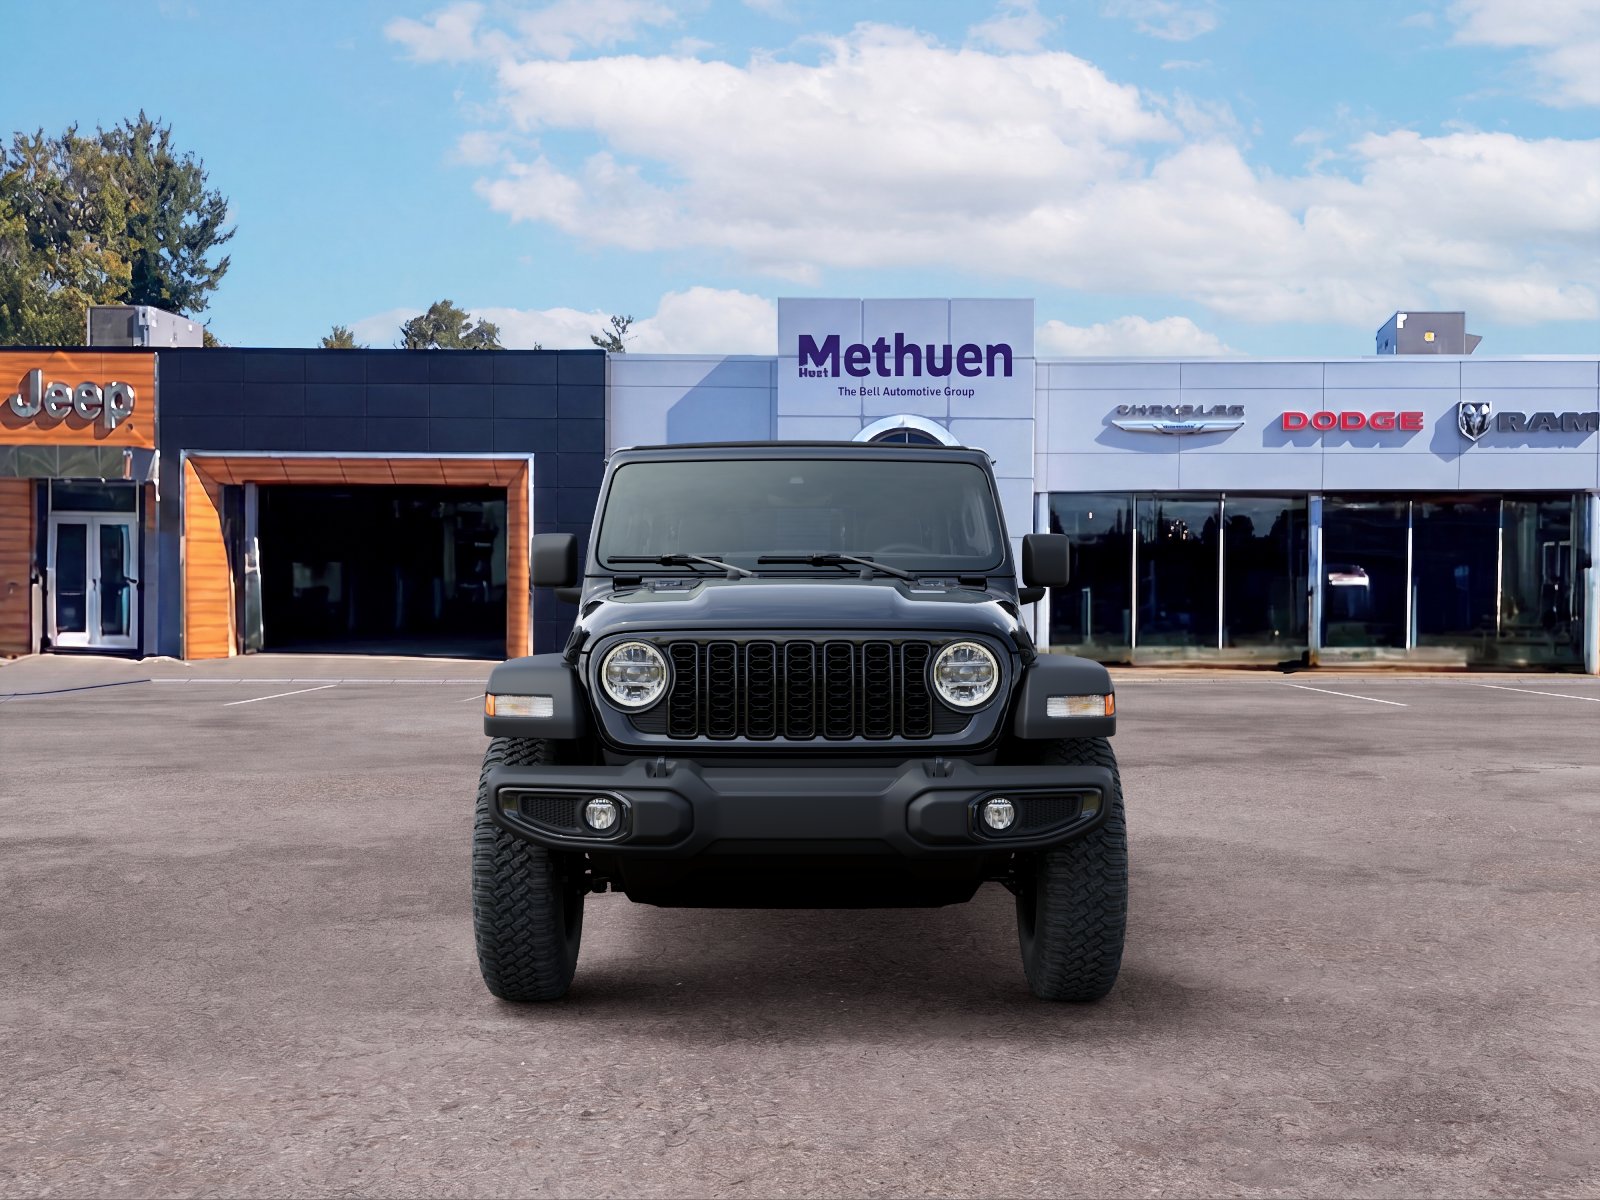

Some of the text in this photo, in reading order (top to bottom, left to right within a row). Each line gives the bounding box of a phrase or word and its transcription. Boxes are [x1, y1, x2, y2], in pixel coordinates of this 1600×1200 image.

[798, 333, 1013, 378] Methuen
[9, 369, 135, 429] Jeep
[838, 386, 975, 399] The Bell Automotive Group
[1282, 411, 1424, 431] DODGE
[1497, 411, 1599, 433] RAM
